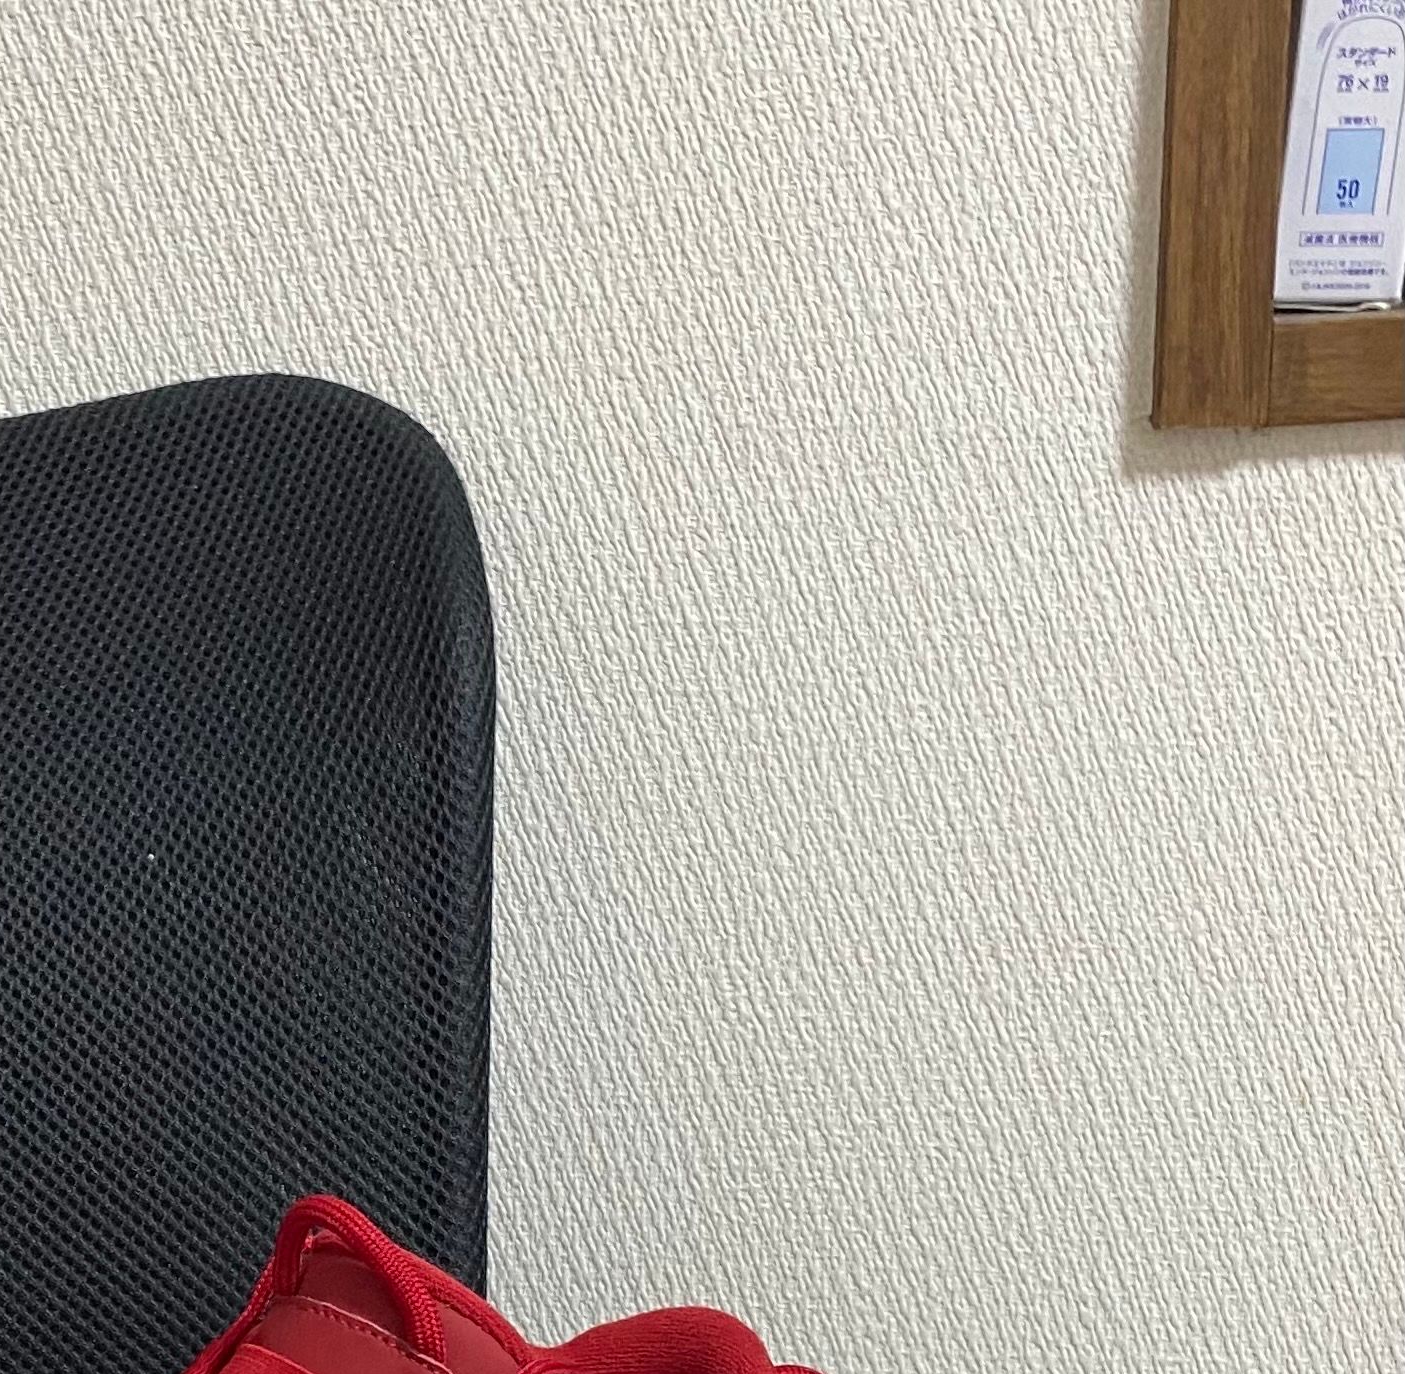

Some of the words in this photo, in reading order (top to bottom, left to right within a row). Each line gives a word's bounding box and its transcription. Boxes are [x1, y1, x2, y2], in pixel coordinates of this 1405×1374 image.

[1337, 73, 1354, 89] 76
[1374, 73, 1389, 89] 19
[1336, 179, 1360, 200] 50
